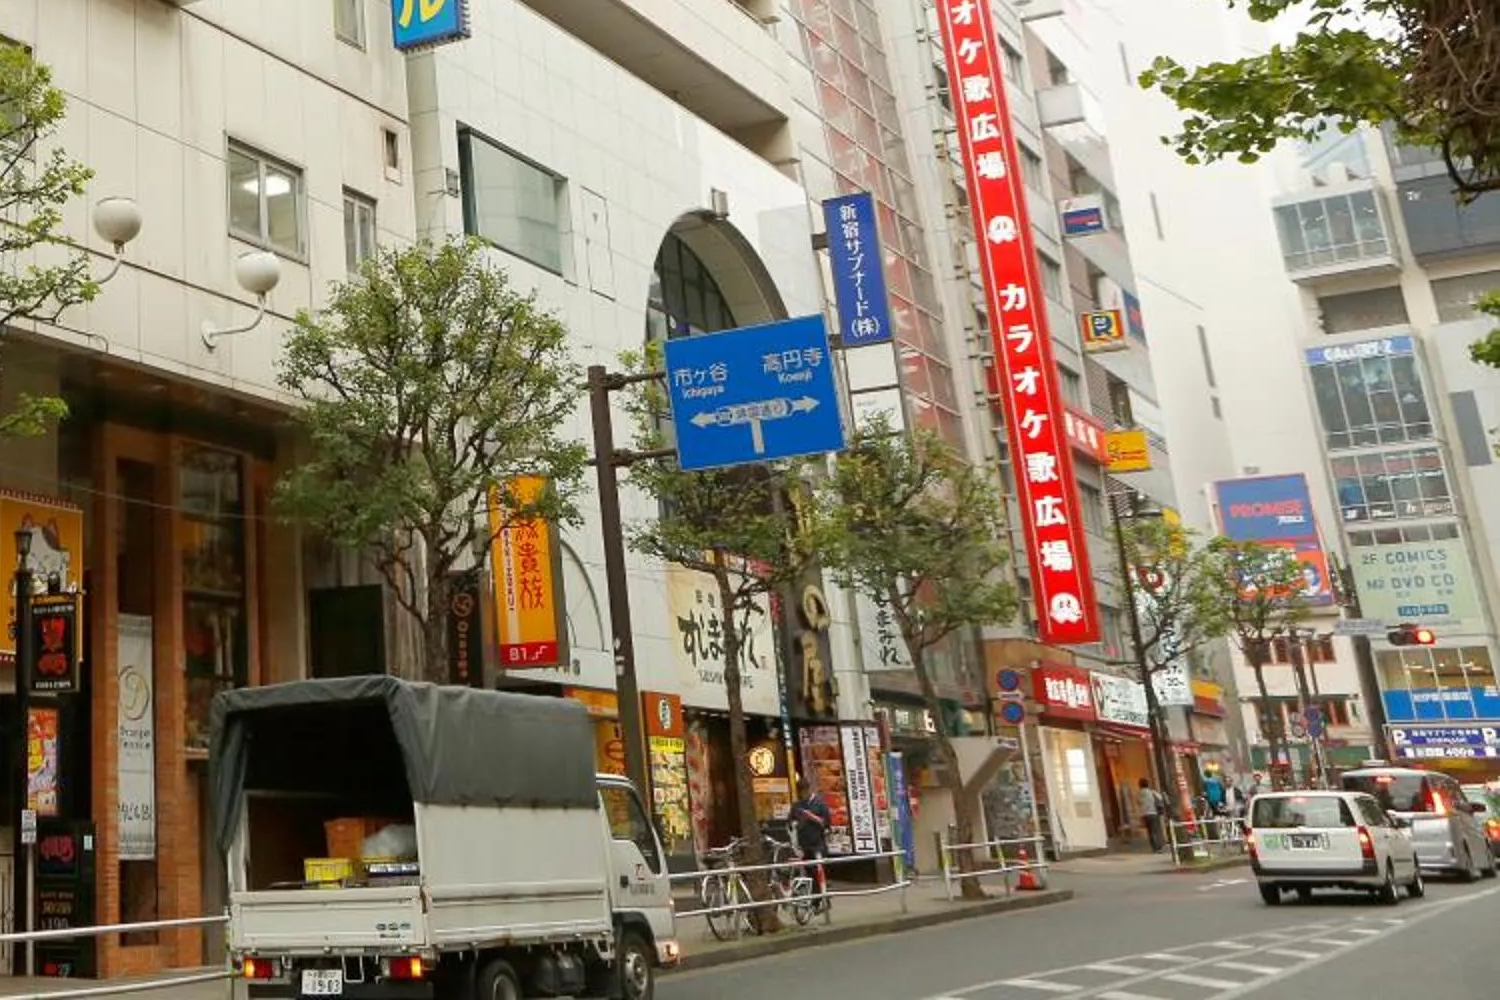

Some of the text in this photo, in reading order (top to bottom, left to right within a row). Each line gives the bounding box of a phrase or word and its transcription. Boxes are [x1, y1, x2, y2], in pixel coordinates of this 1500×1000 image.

[762, 347, 824, 375] 高円寺
[673, 362, 729, 387] 市ヶ谷
[999, 282, 1072, 573] カラオケ歌広場
[1385, 548, 1447, 565] COMICS
[1391, 575, 1426, 590] DVD
